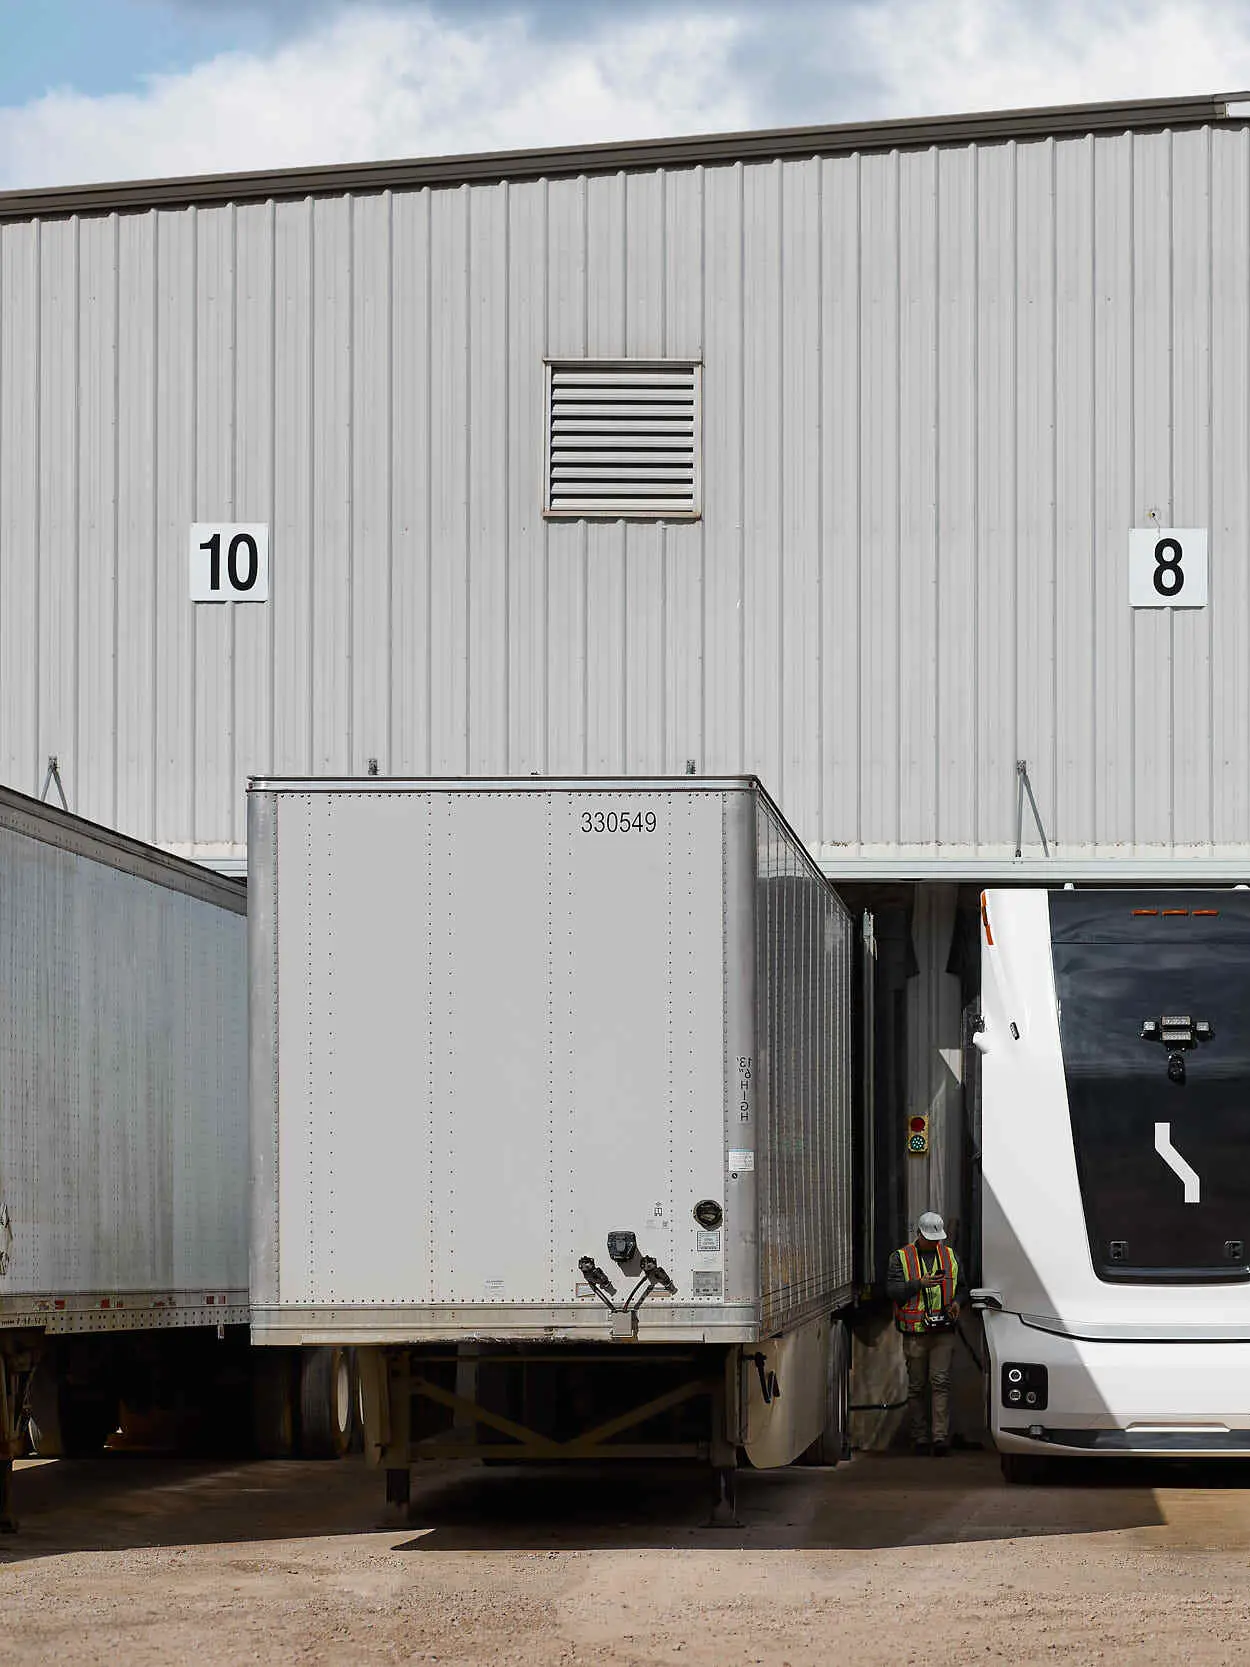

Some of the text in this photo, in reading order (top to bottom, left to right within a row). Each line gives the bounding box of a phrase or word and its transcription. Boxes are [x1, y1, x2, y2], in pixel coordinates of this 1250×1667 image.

[199, 533, 259, 592] 10
[1153, 537, 1185, 597] 8
[581, 811, 657, 833] 330549
